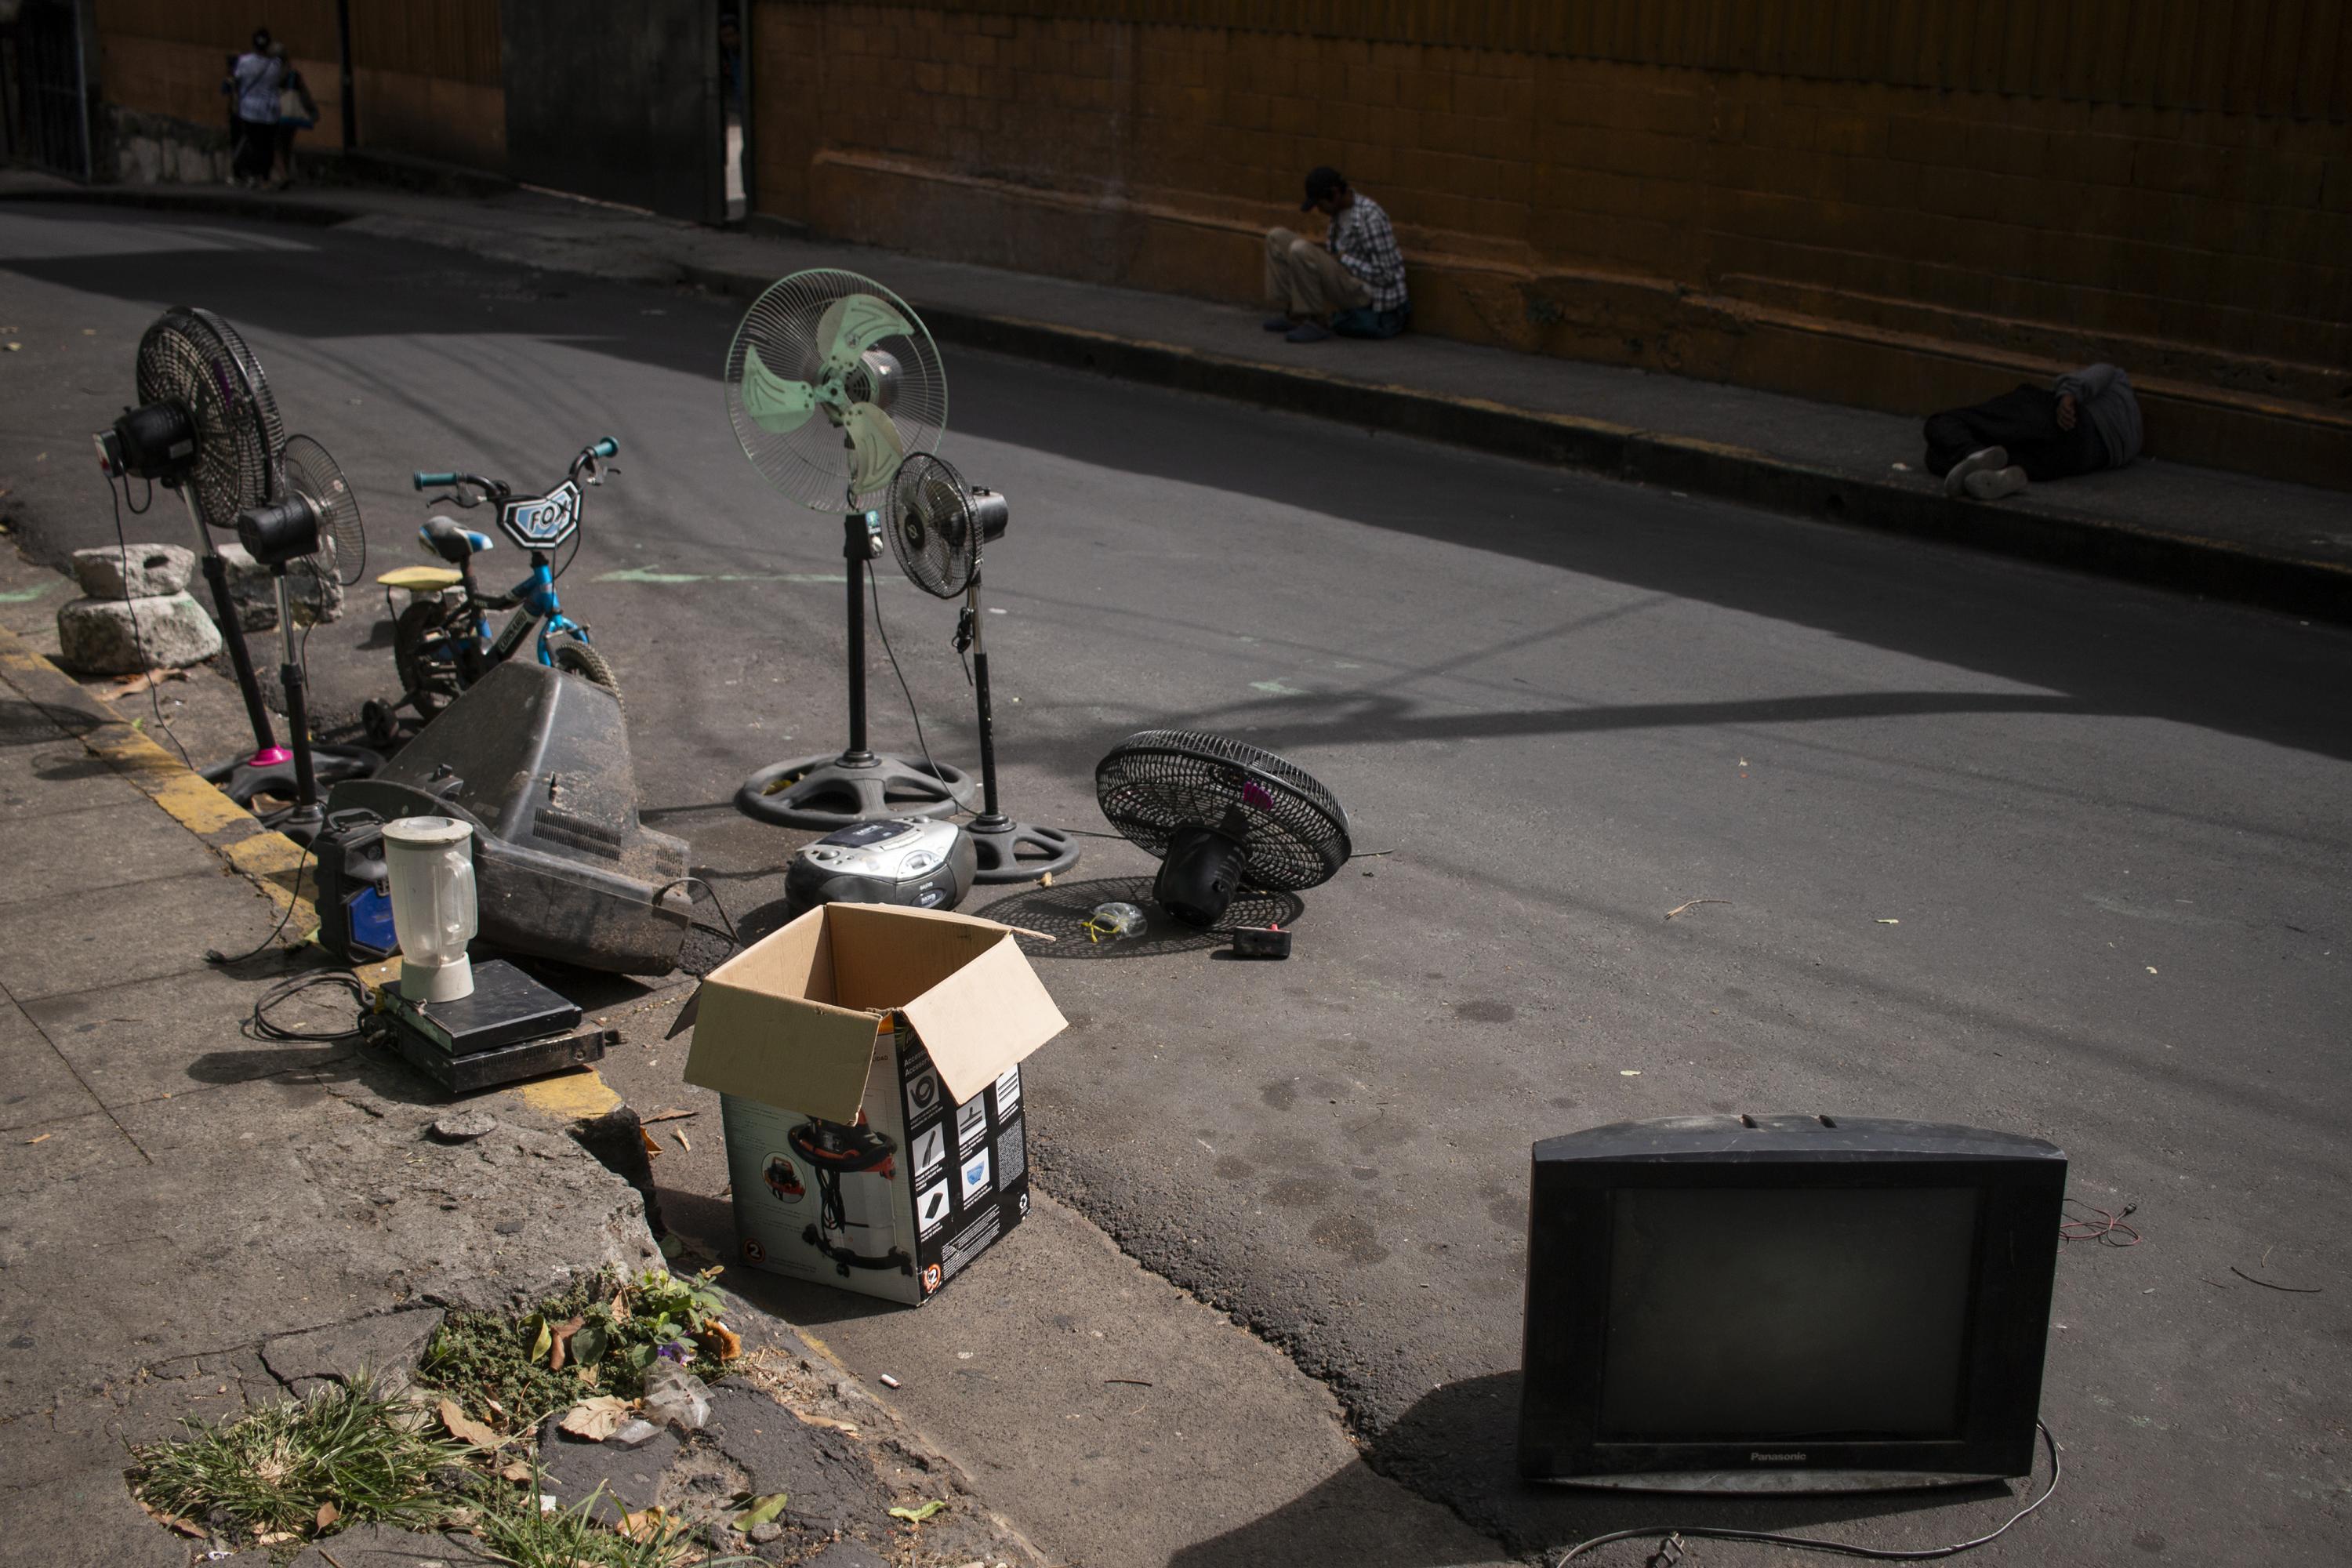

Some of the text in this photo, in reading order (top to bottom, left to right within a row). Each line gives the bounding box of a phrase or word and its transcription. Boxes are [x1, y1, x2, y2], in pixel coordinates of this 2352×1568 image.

[529, 499, 571, 533] FOX
[749, 1243, 760, 1258] 2
[1750, 1451, 1806, 1461] Panasonic
